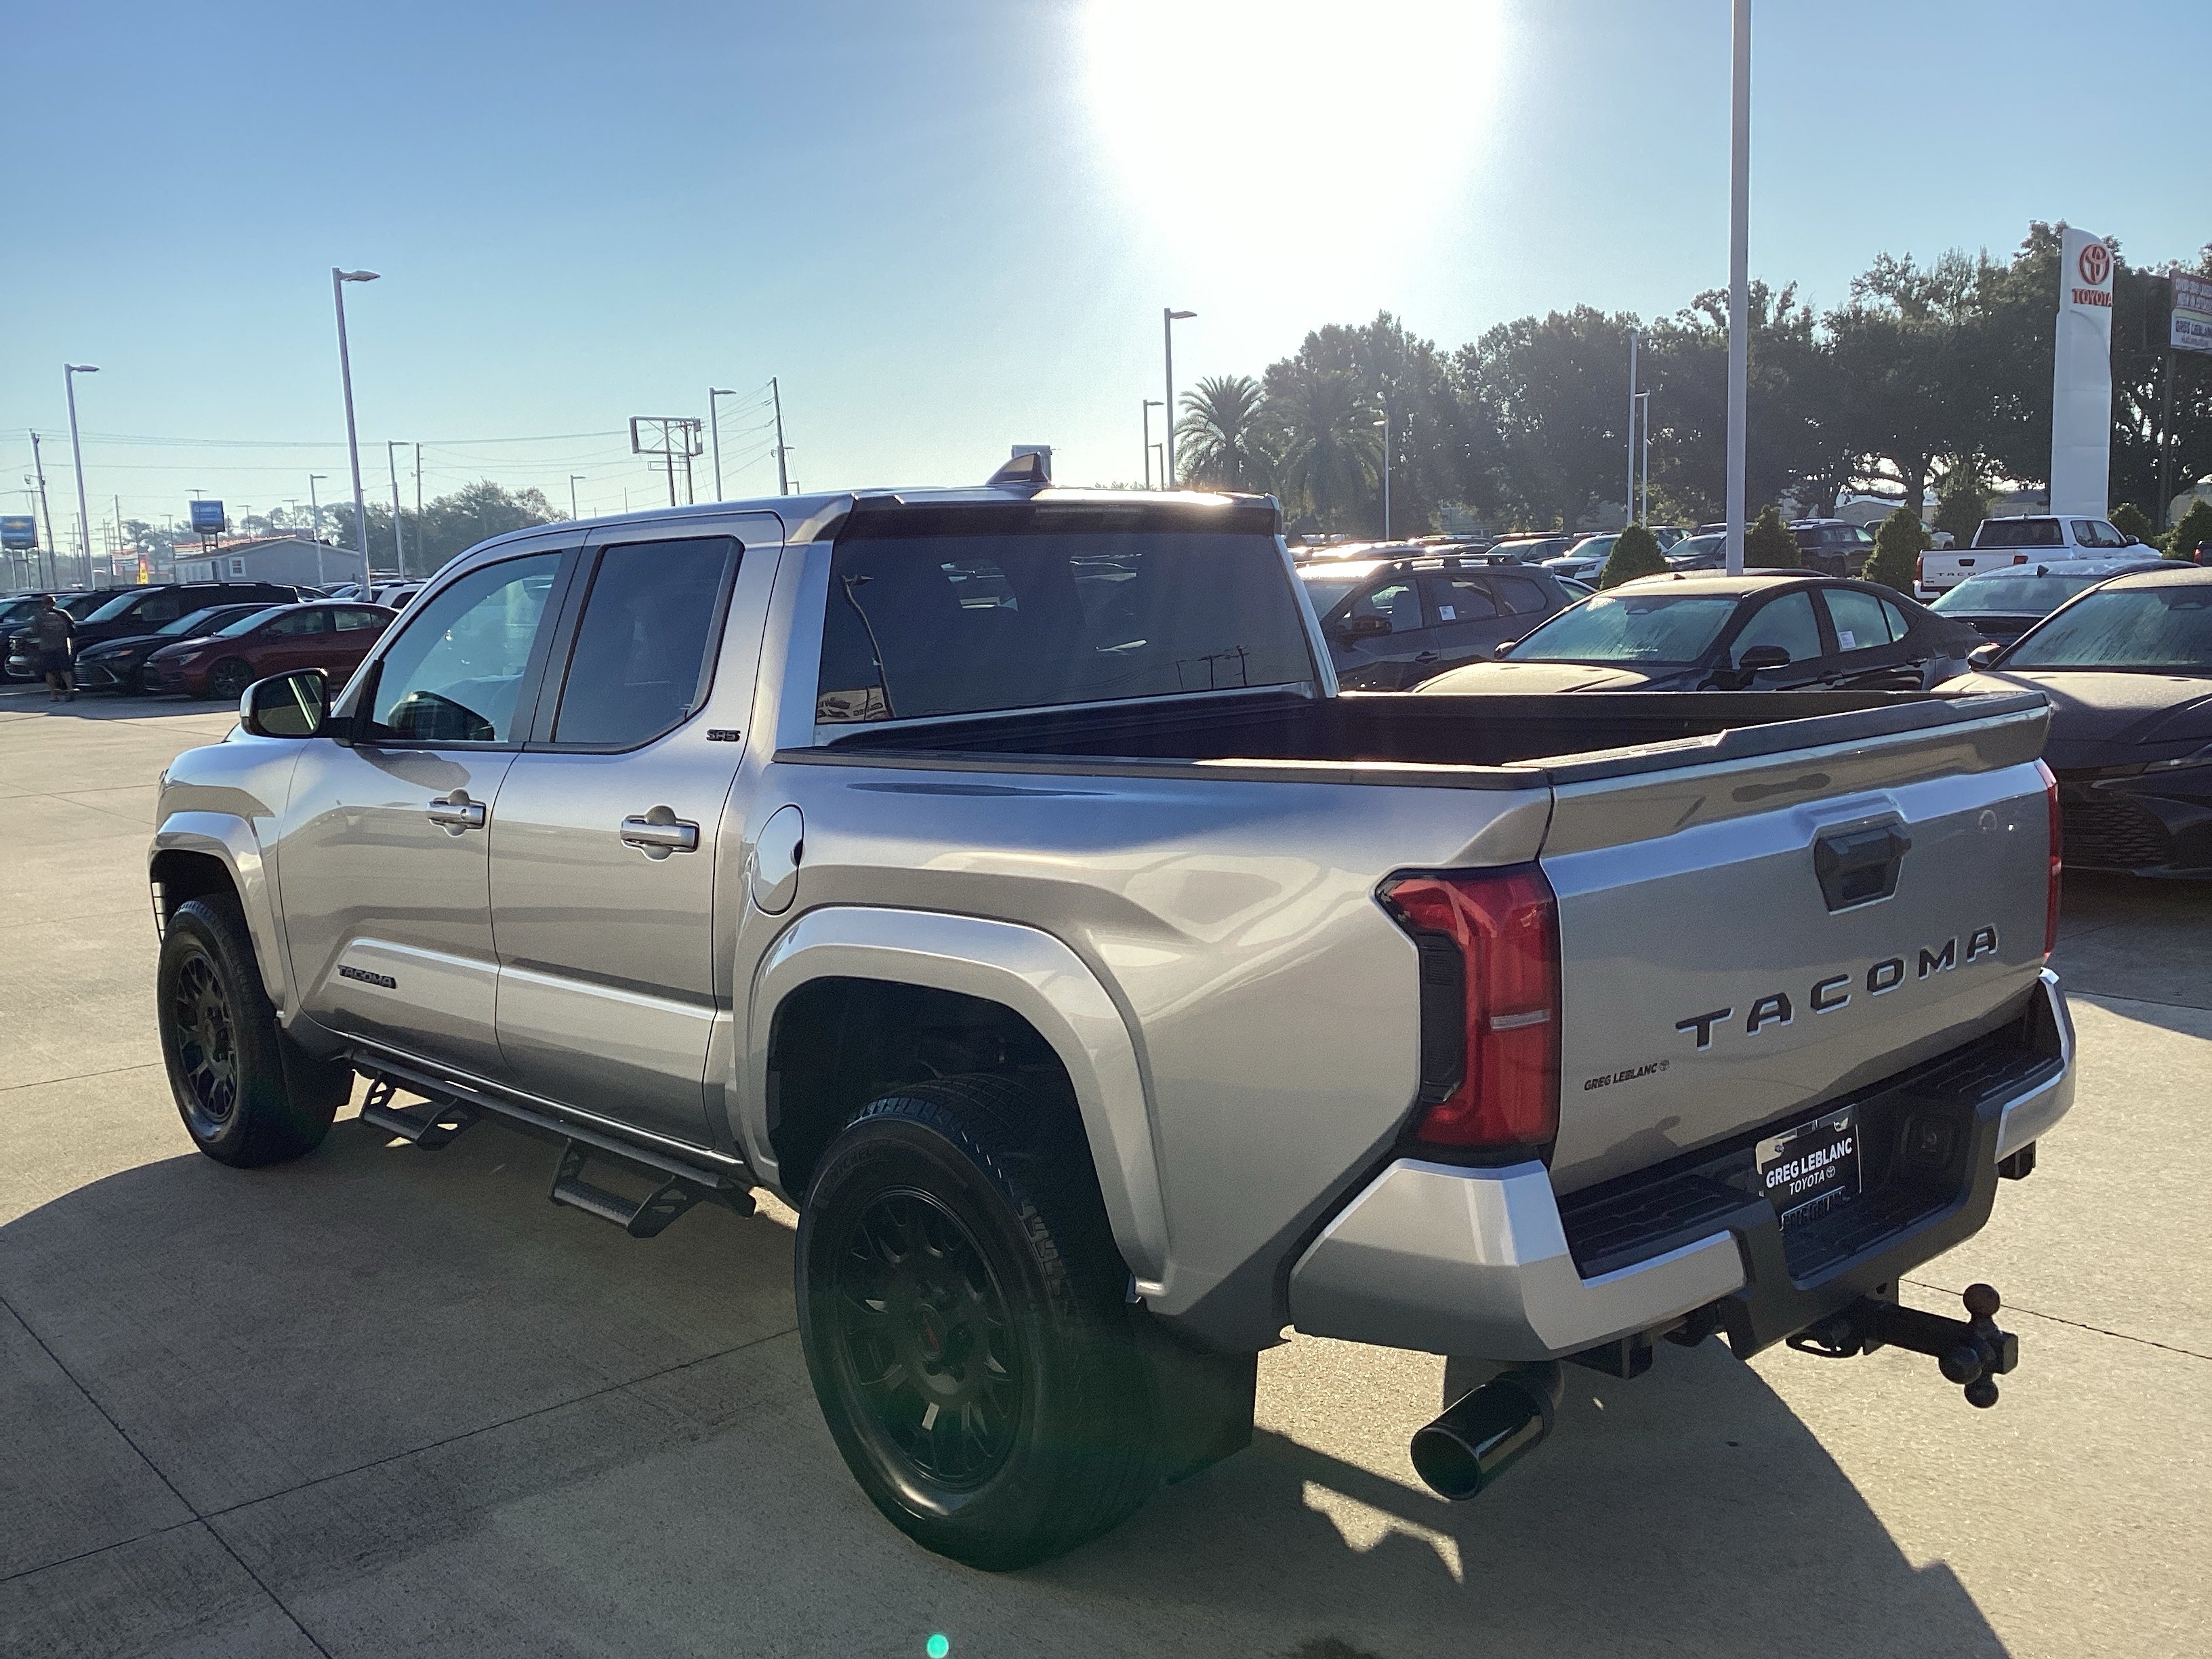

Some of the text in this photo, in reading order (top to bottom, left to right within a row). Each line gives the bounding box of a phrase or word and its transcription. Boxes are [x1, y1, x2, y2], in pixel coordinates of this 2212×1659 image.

[2072, 288, 2112, 307] TOYOTA
[706, 729, 740, 741] SR5
[337, 964, 396, 989] TACOMA
[1675, 924, 1999, 1052] TACOMA
[1584, 1062, 1658, 1091] GREG LEBLANC
[1765, 1137, 1853, 1189] GREG LEBLANC
[1789, 1169, 1825, 1195] TOYOTA
